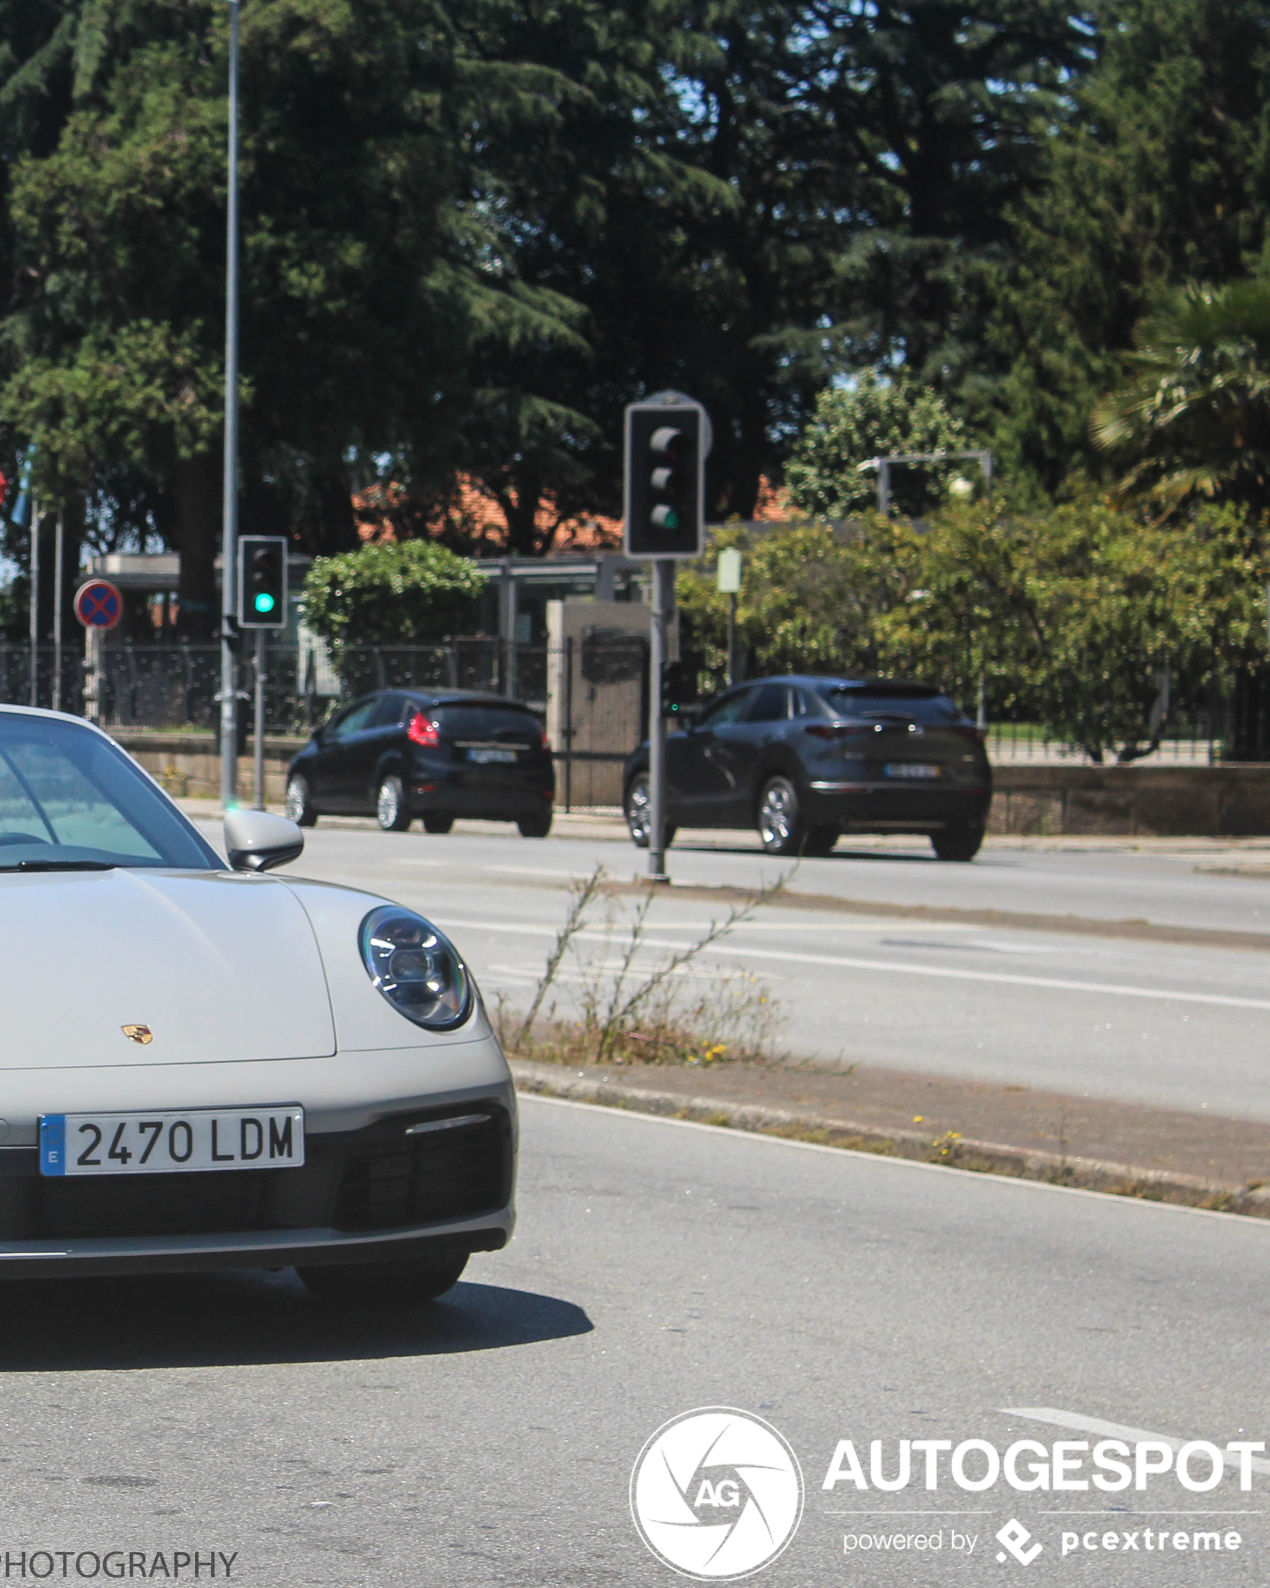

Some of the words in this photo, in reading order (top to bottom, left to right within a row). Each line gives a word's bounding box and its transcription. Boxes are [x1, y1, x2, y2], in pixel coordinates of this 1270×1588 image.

[76, 1120, 193, 1166] 2470
[211, 1116, 293, 1162] LDM
[48, 1151, 59, 1163] E
